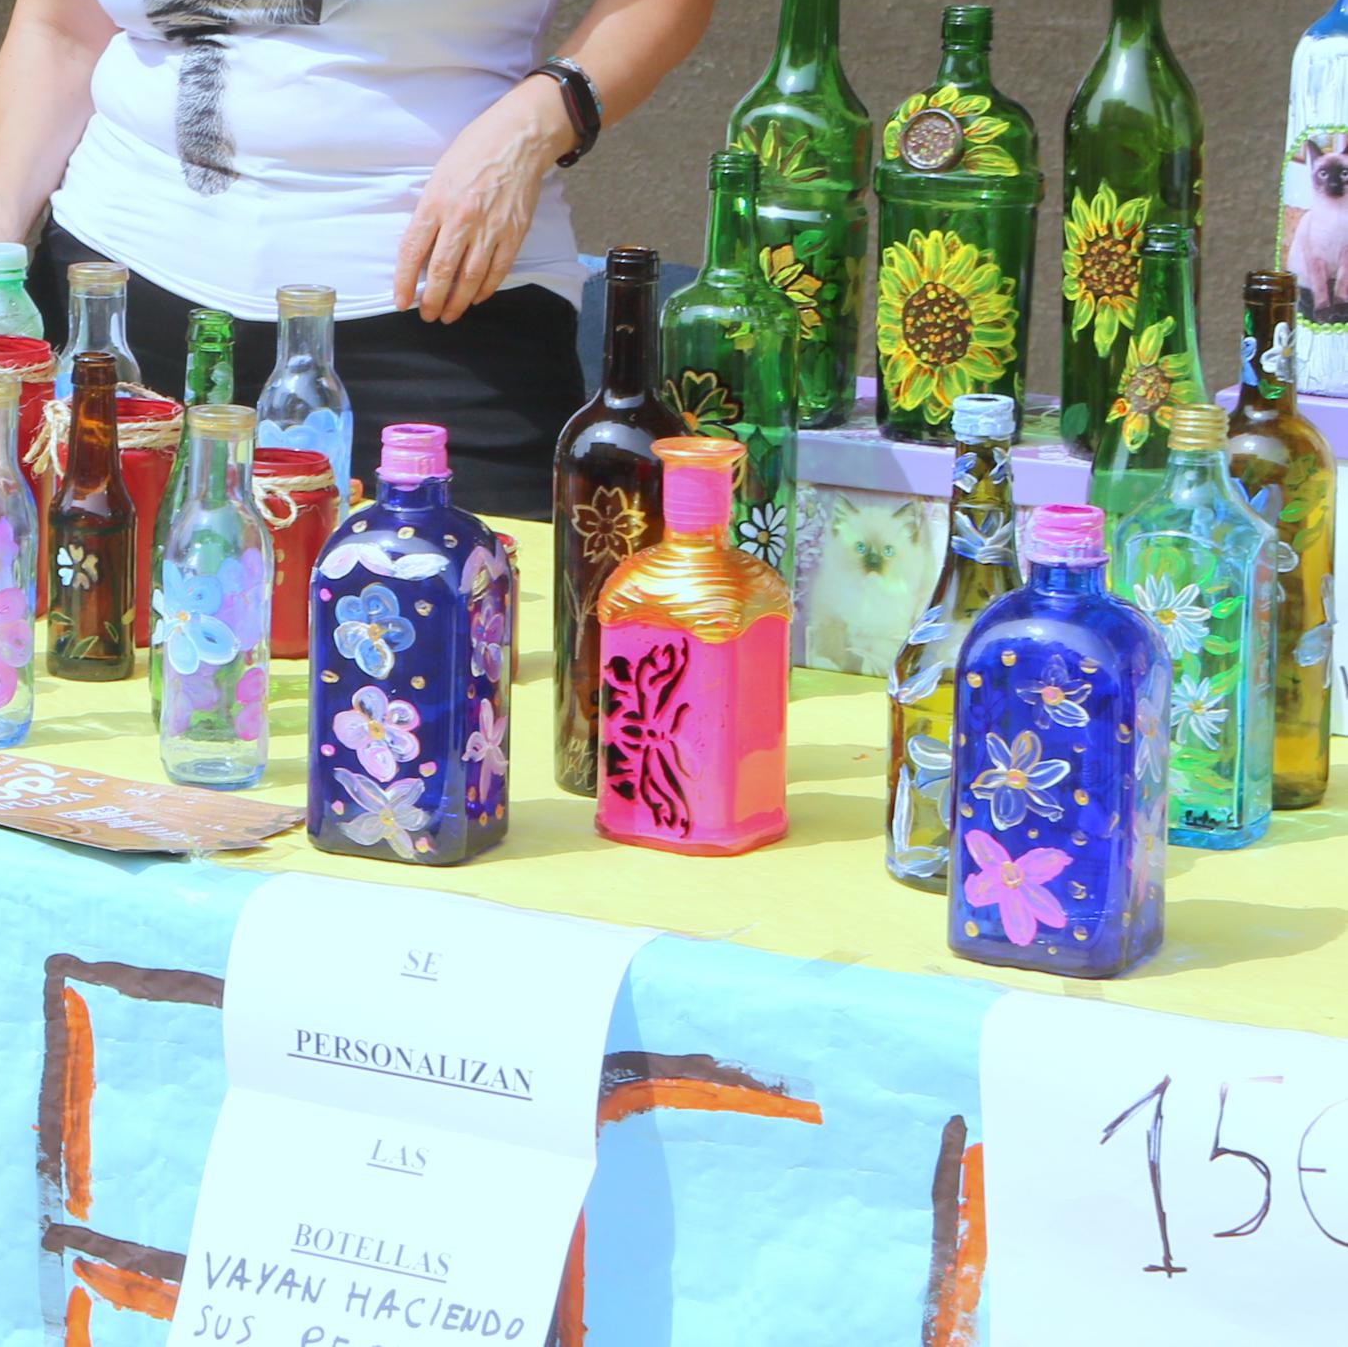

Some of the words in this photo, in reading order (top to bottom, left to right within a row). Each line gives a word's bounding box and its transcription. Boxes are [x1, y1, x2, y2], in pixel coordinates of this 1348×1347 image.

[402, 948, 443, 978] SE
[294, 1028, 535, 1094] PERSONALIZAN
[370, 1137, 431, 1171] LAS
[293, 1222, 452, 1278] BOTELLAS
[204, 1250, 327, 1305] VAYAN
[345, 1281, 526, 1340] HACIENDO
[193, 1304, 256, 1345] SUS
